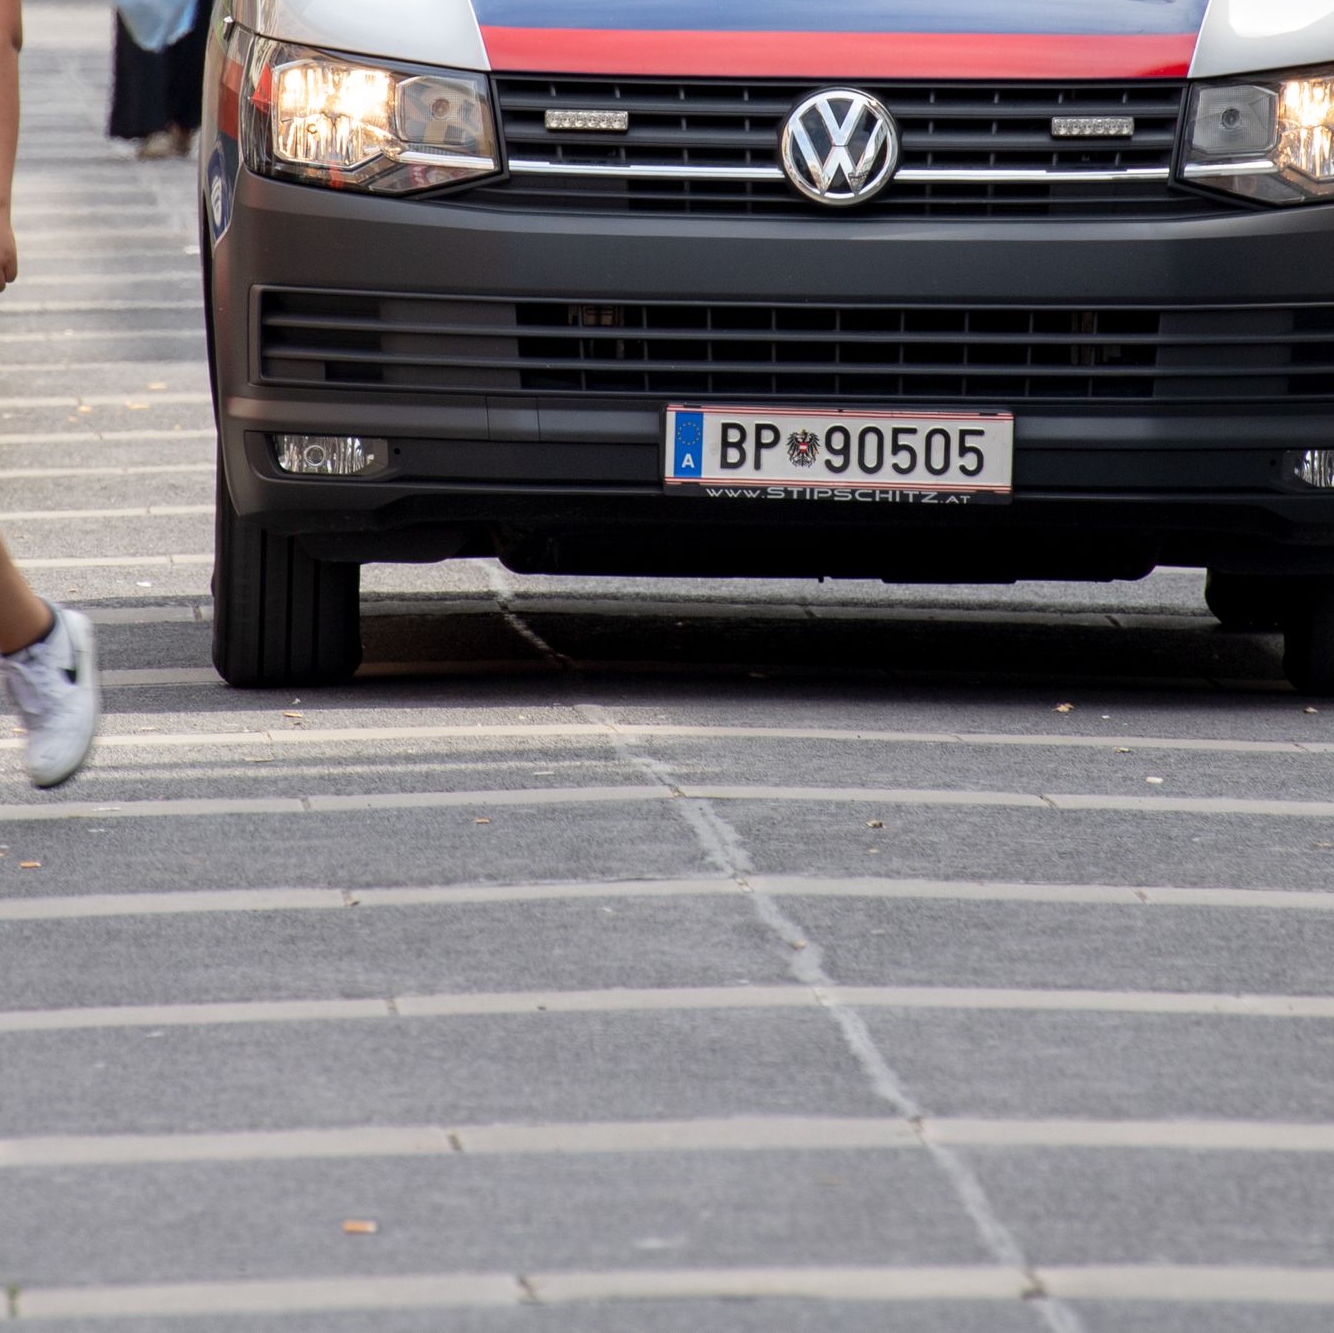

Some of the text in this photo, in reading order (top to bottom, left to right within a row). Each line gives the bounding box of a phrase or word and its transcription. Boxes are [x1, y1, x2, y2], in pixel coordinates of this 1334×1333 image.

[681, 452, 695, 469] A
[719, 421, 986, 476] BP 90505
